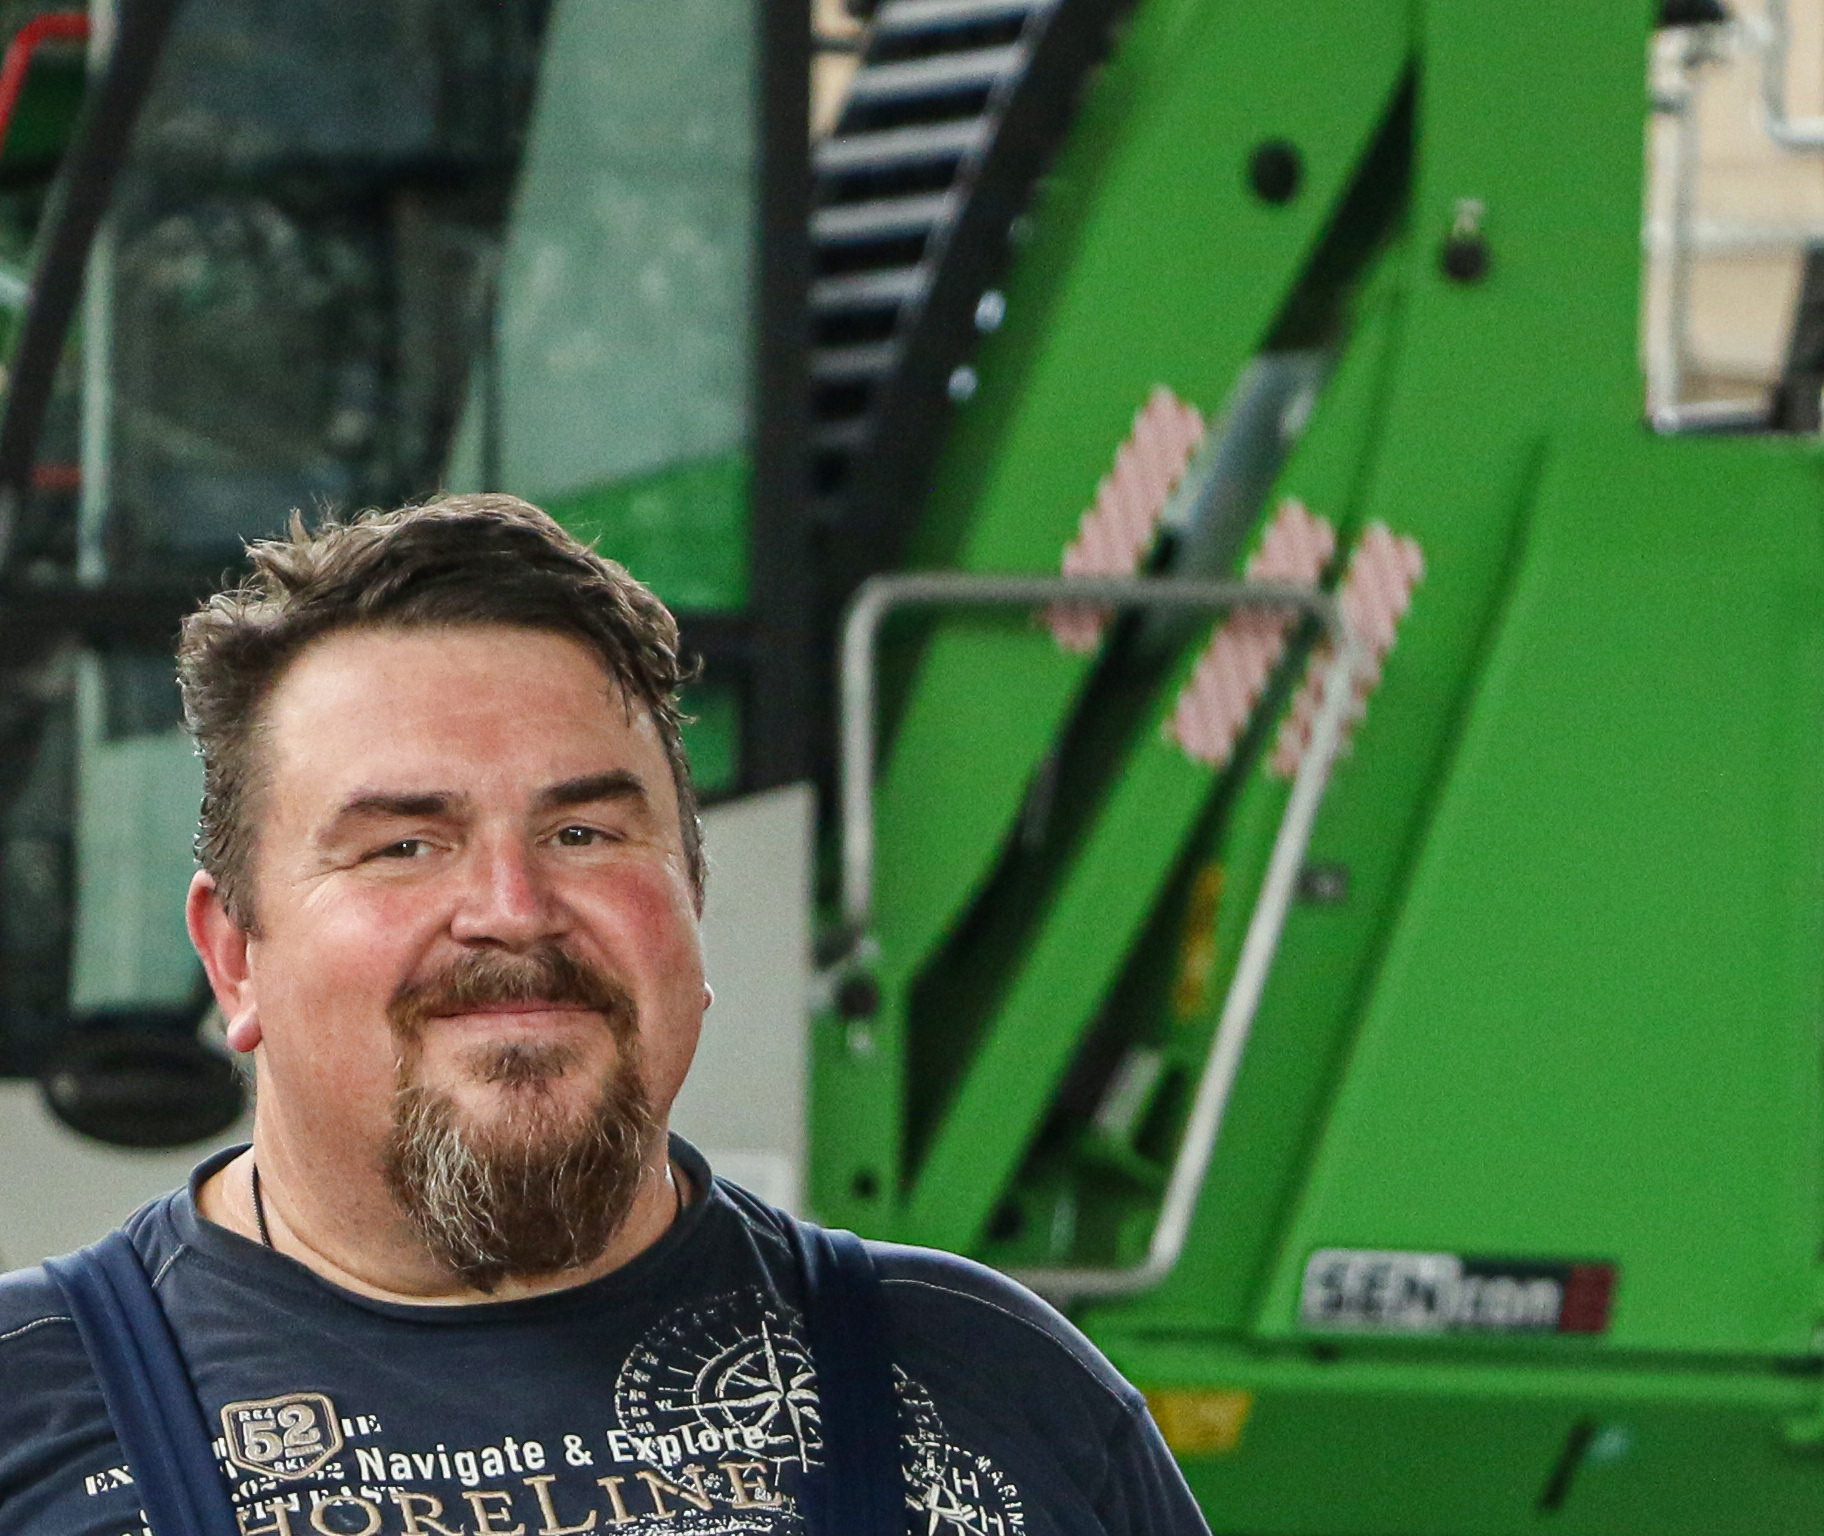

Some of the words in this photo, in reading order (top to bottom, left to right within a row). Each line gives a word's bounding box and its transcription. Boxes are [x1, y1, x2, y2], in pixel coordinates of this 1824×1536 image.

[243, 1404, 320, 1461] 52
[354, 1436, 546, 1487] Navigate
[563, 1434, 594, 1466] &
[606, 1424, 766, 1467] Explore
